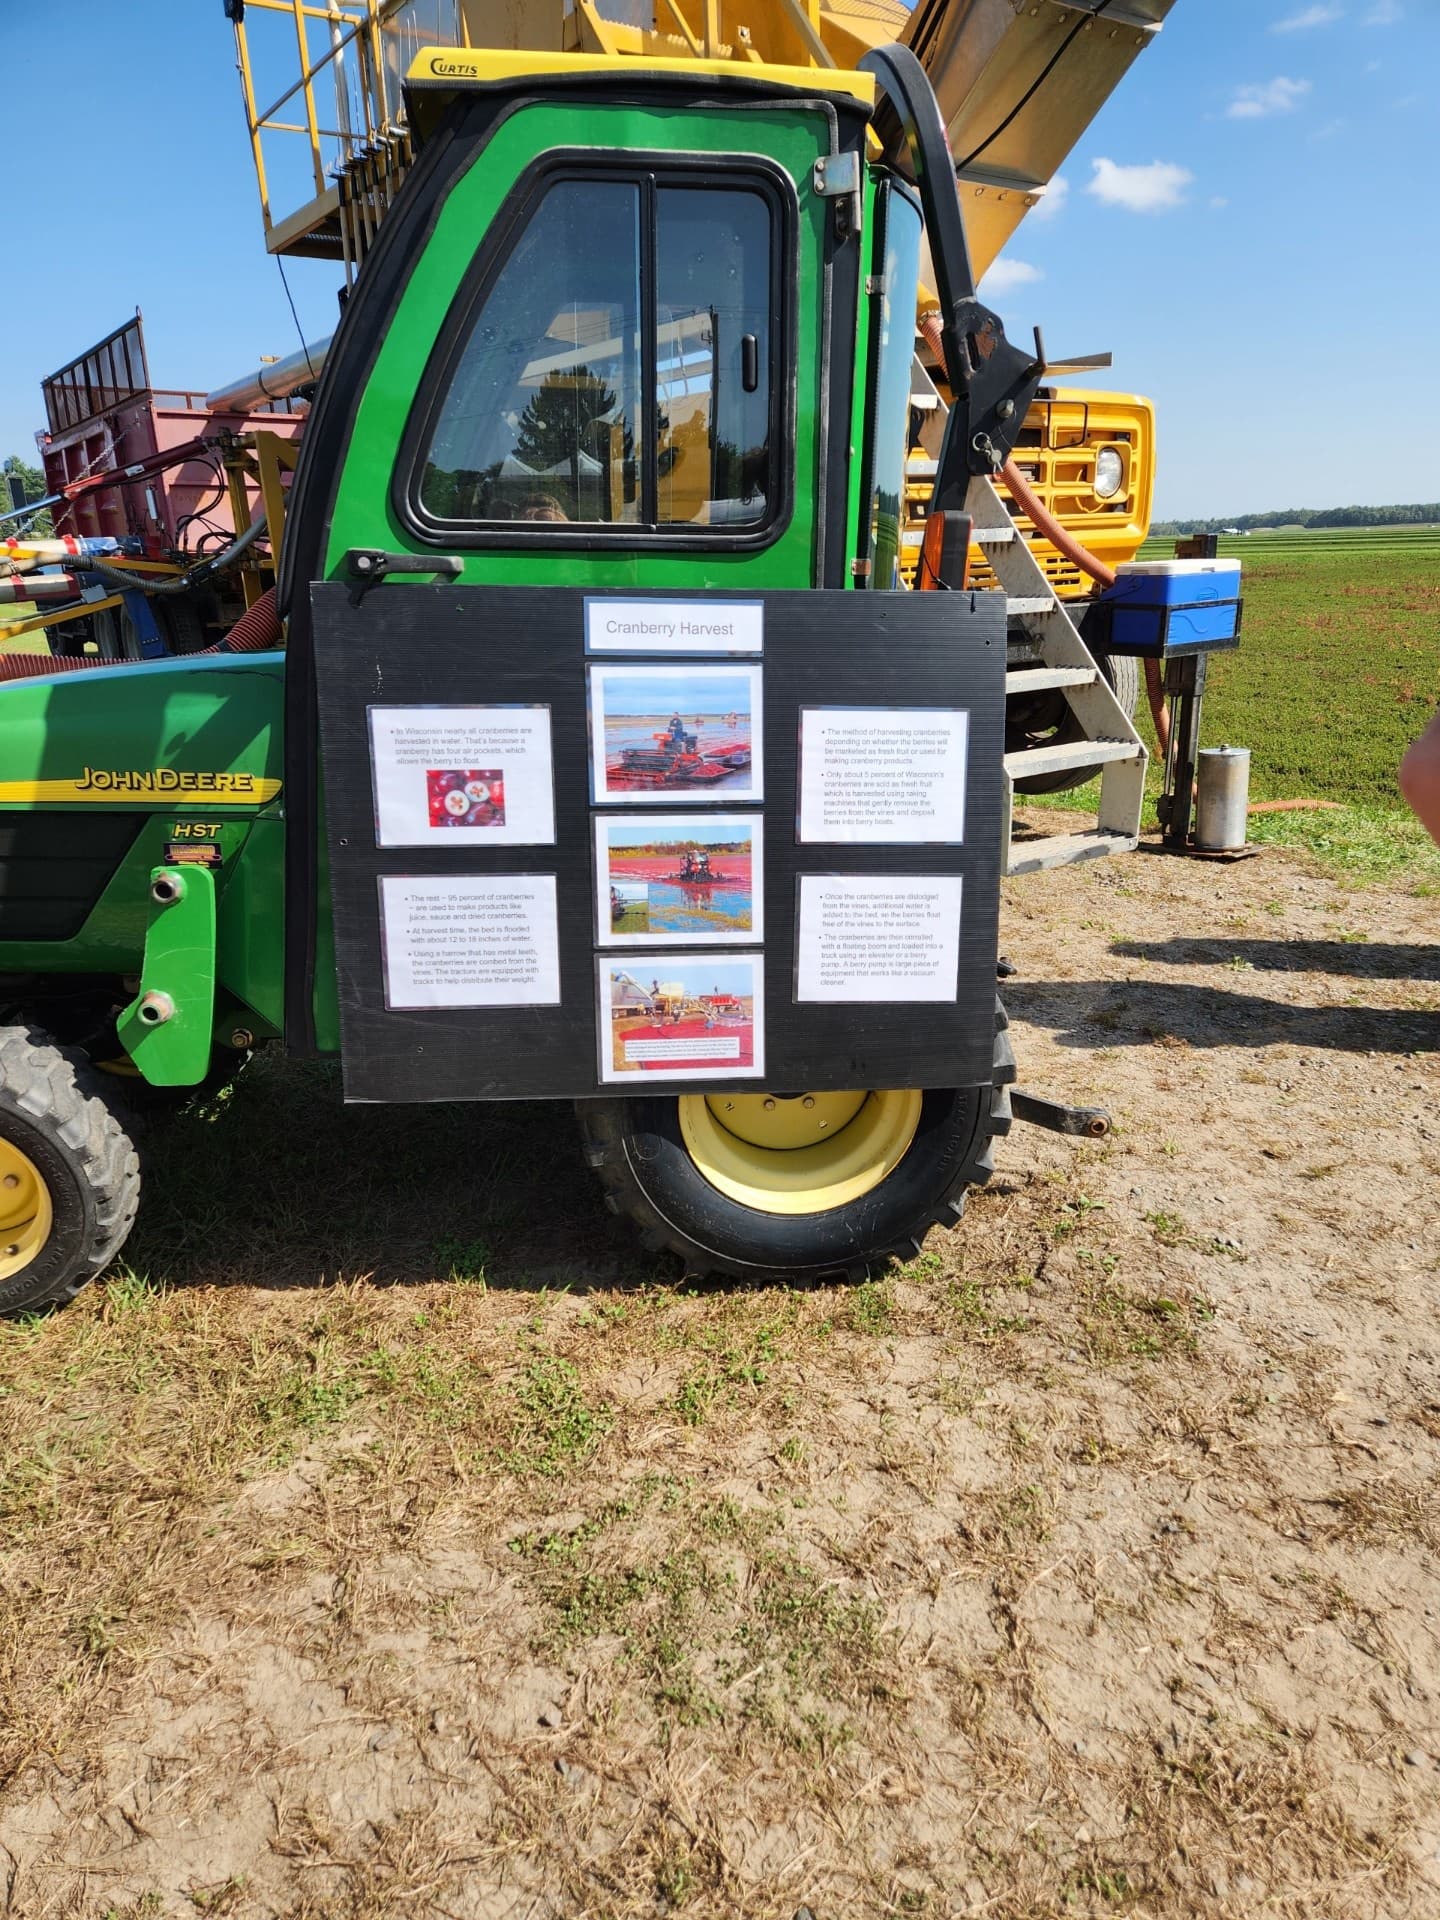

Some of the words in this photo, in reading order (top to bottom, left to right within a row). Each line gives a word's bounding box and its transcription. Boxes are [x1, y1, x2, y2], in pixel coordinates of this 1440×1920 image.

[606, 620, 676, 638] Cranberry
[680, 621, 734, 636] Harvest
[75, 767, 154, 790] JOHN
[155, 768, 254, 792] DEERE
[174, 823, 222, 838] HST
